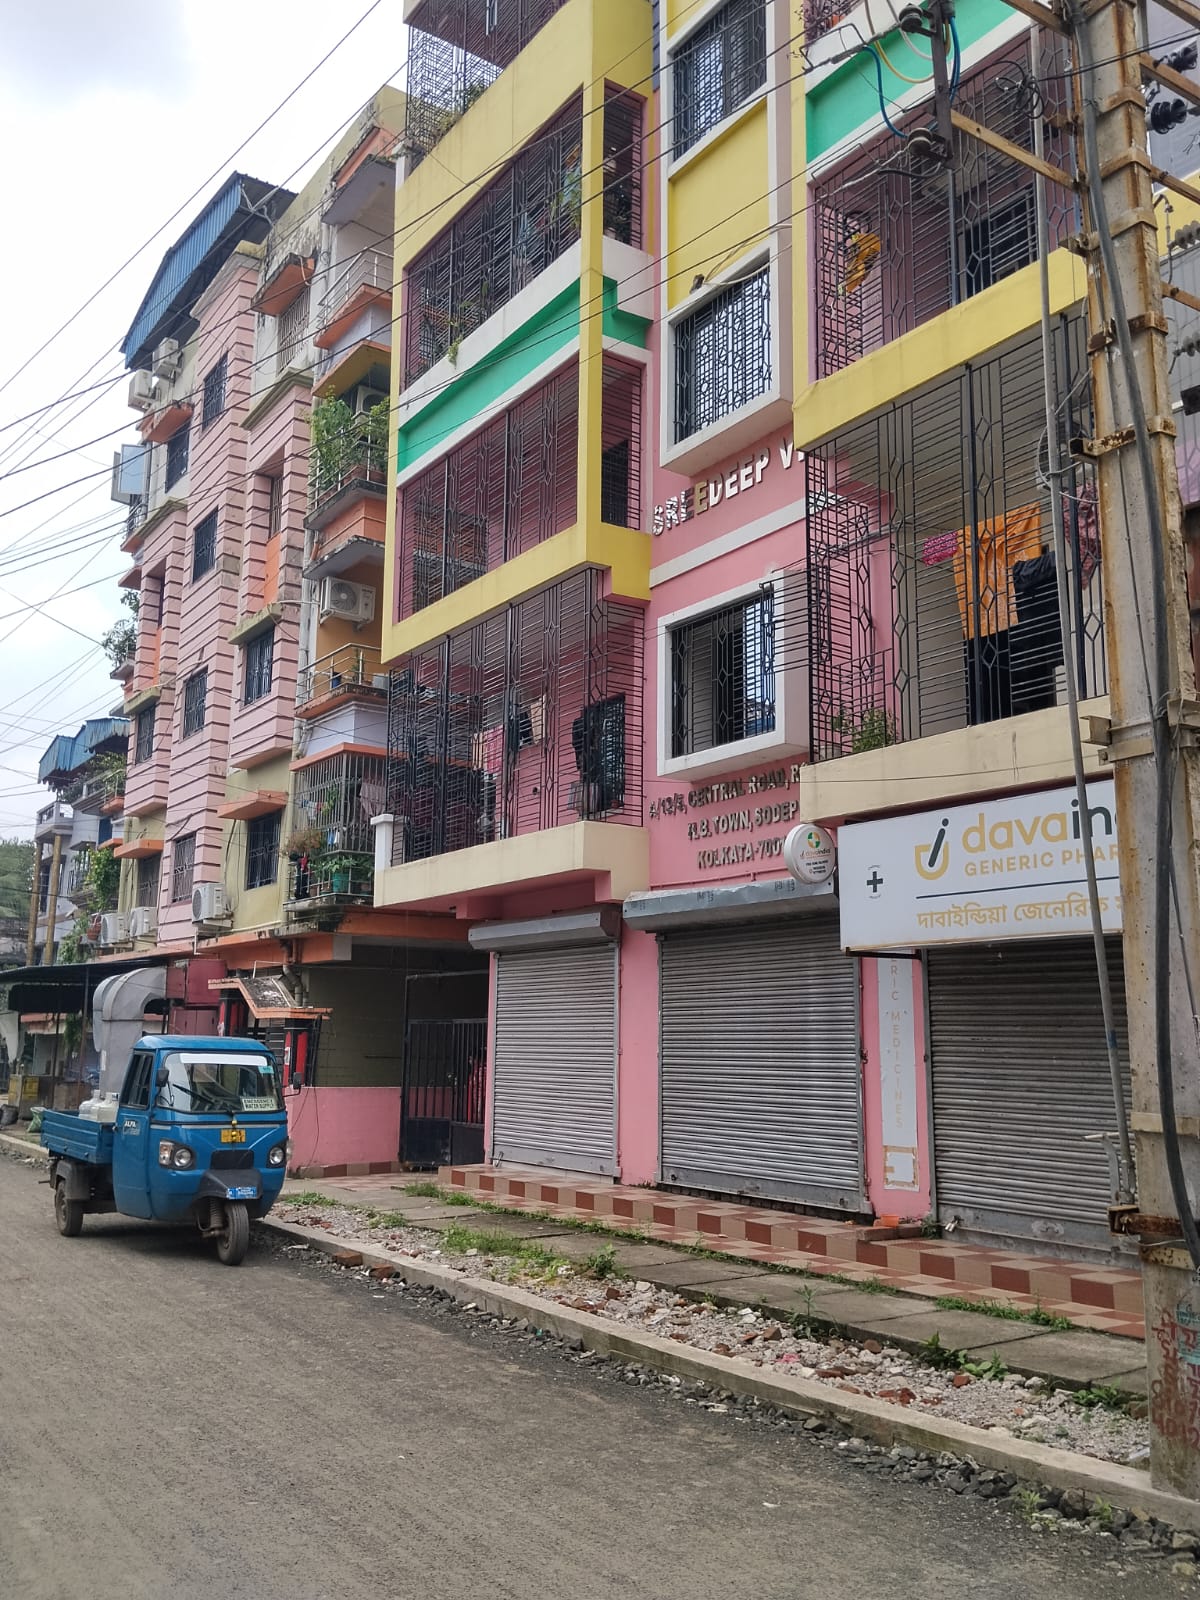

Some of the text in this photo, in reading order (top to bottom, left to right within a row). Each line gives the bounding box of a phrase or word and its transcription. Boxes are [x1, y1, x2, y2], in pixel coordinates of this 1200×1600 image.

[652, 437, 805, 536] SREEDEEP V
[688, 778, 746, 808] CENTRAL
[748, 768, 790, 794] ROAD,
[712, 809, 753, 834] TOWN,
[755, 800, 799, 826] SODEP
[962, 799, 1118, 854] davain
[697, 836, 786, 869] KOLKATA-7001
[964, 842, 1118, 877] GENERIC PHAR
[890, 959, 900, 1000] RIC
